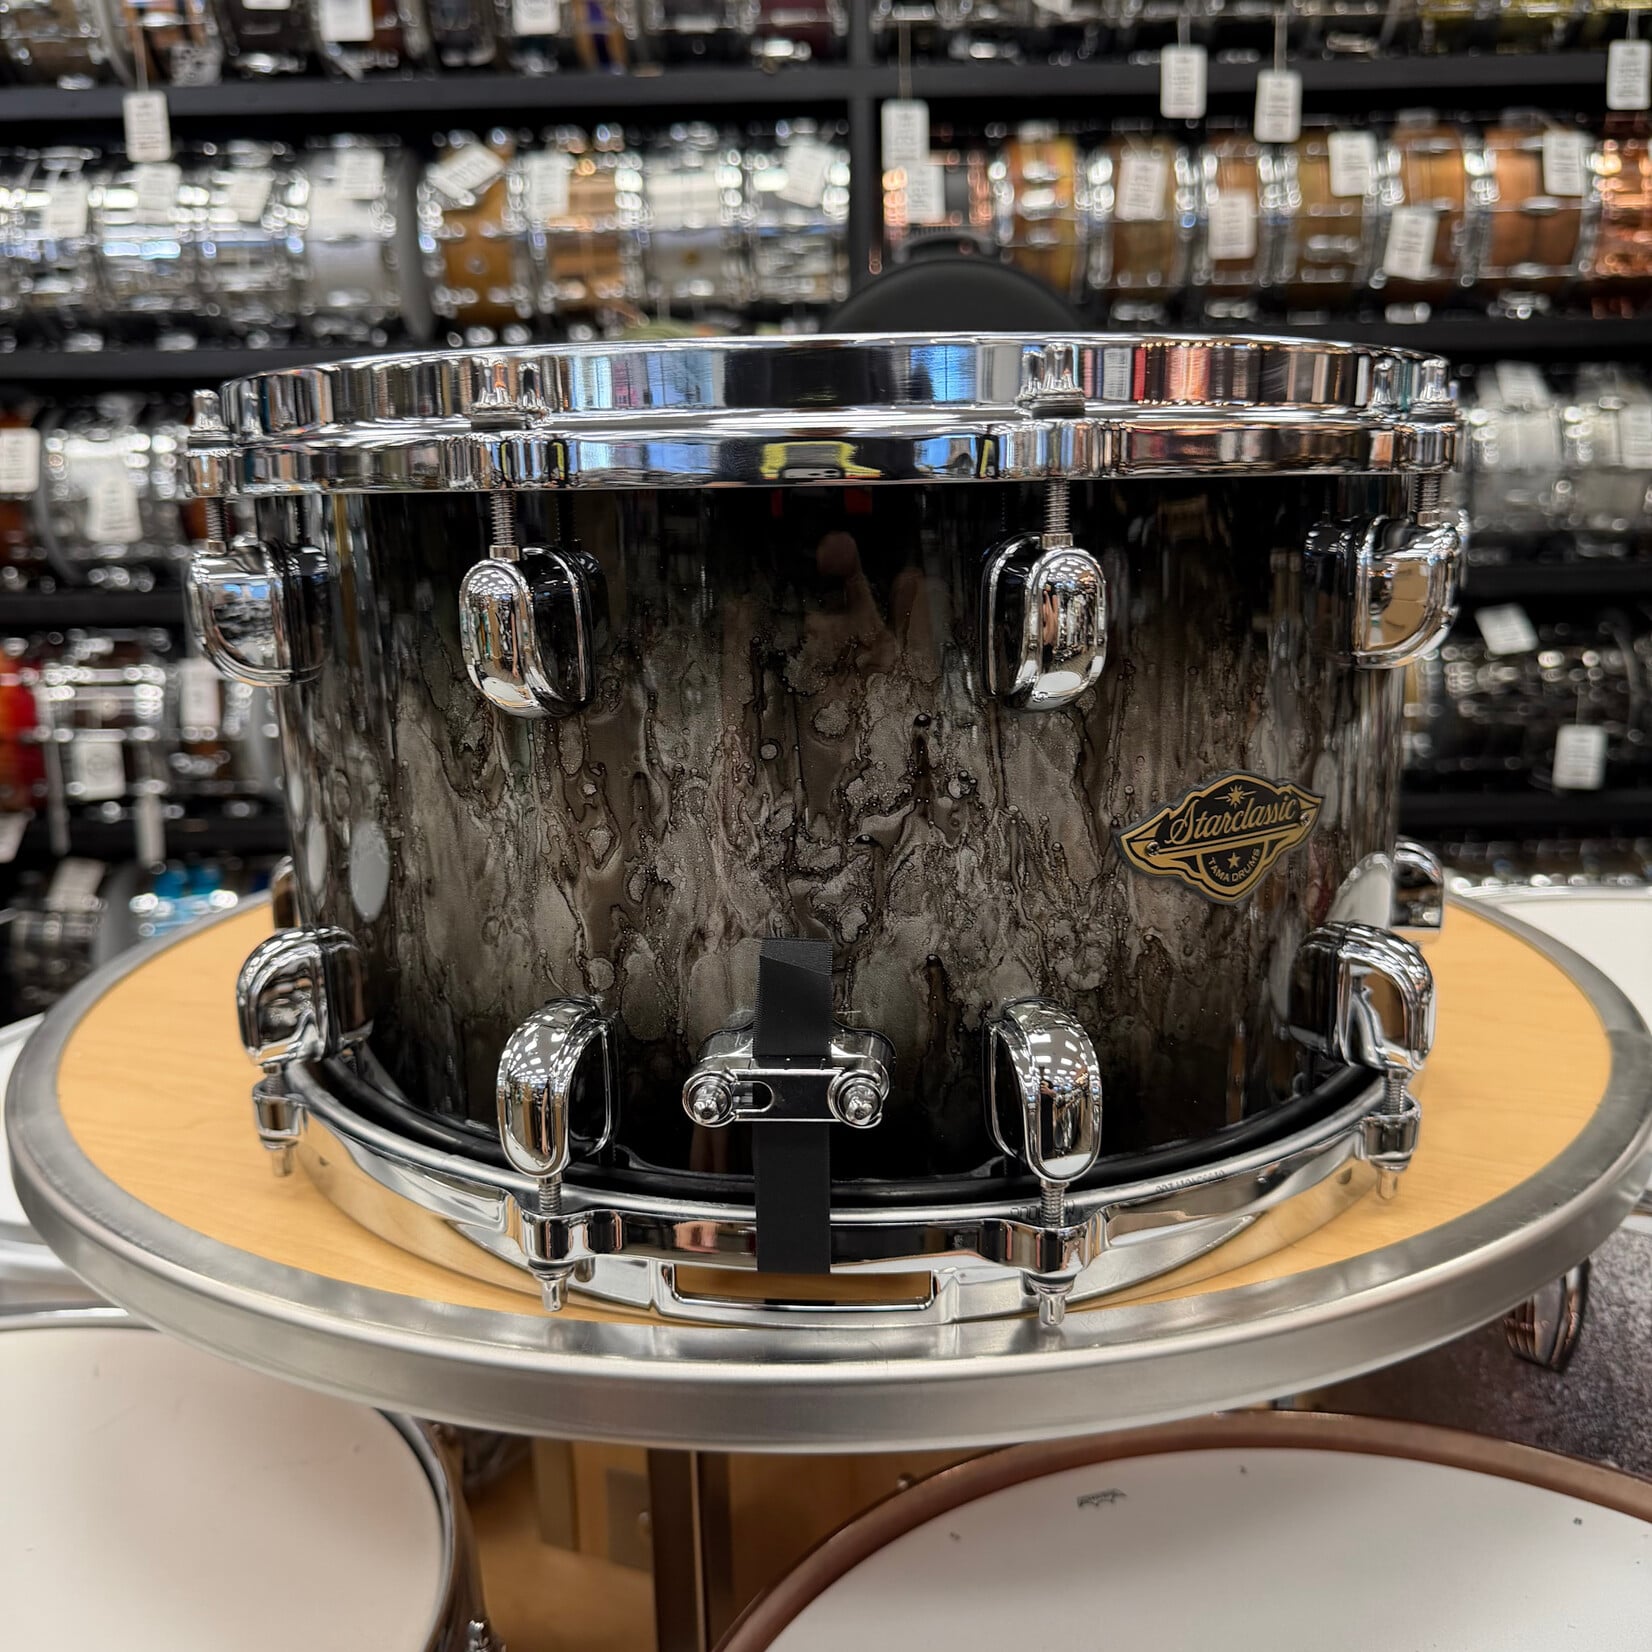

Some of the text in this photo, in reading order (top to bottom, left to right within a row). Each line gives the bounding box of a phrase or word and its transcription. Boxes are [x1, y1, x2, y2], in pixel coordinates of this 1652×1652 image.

[1164, 796, 1297, 845] Starclassic
[1208, 848, 1261, 882] TAMA DRUMS
